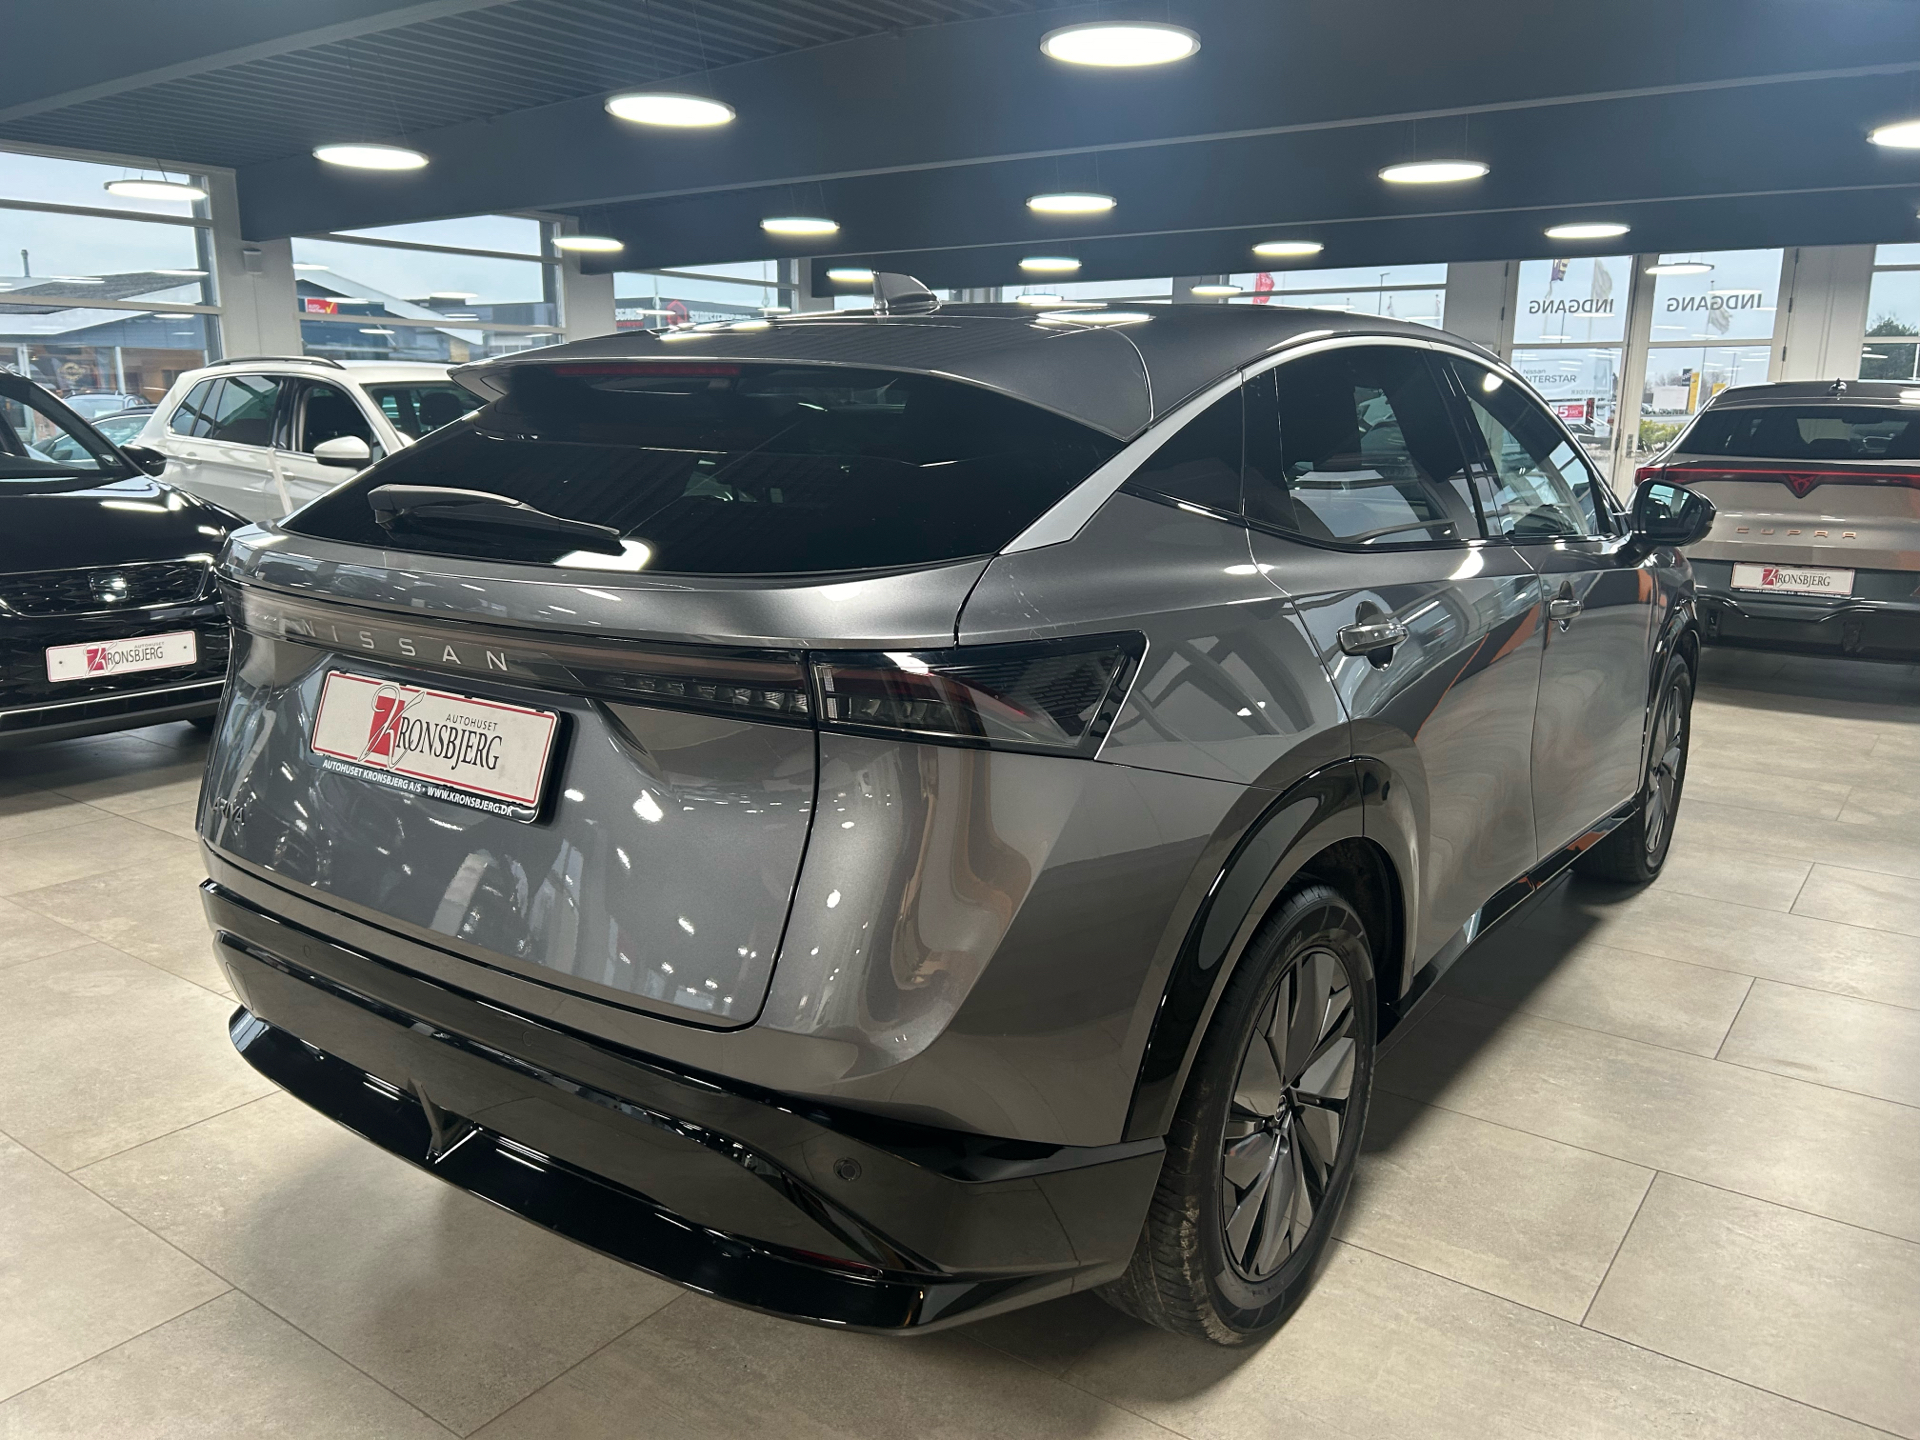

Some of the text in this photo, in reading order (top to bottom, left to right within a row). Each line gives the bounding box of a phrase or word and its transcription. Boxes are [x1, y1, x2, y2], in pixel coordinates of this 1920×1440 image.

[1525, 374, 1577, 383] NTERSTAR
[1736, 526, 1857, 539] CUPRA
[301, 619, 508, 671] NISSAN
[358, 684, 503, 770] KRONSBJERG
[445, 713, 499, 732] AUTOHUSET
[322, 760, 513, 817] AUTOHUSET KRONSBJERG A/S WWW.KRONSBJERG.DK
